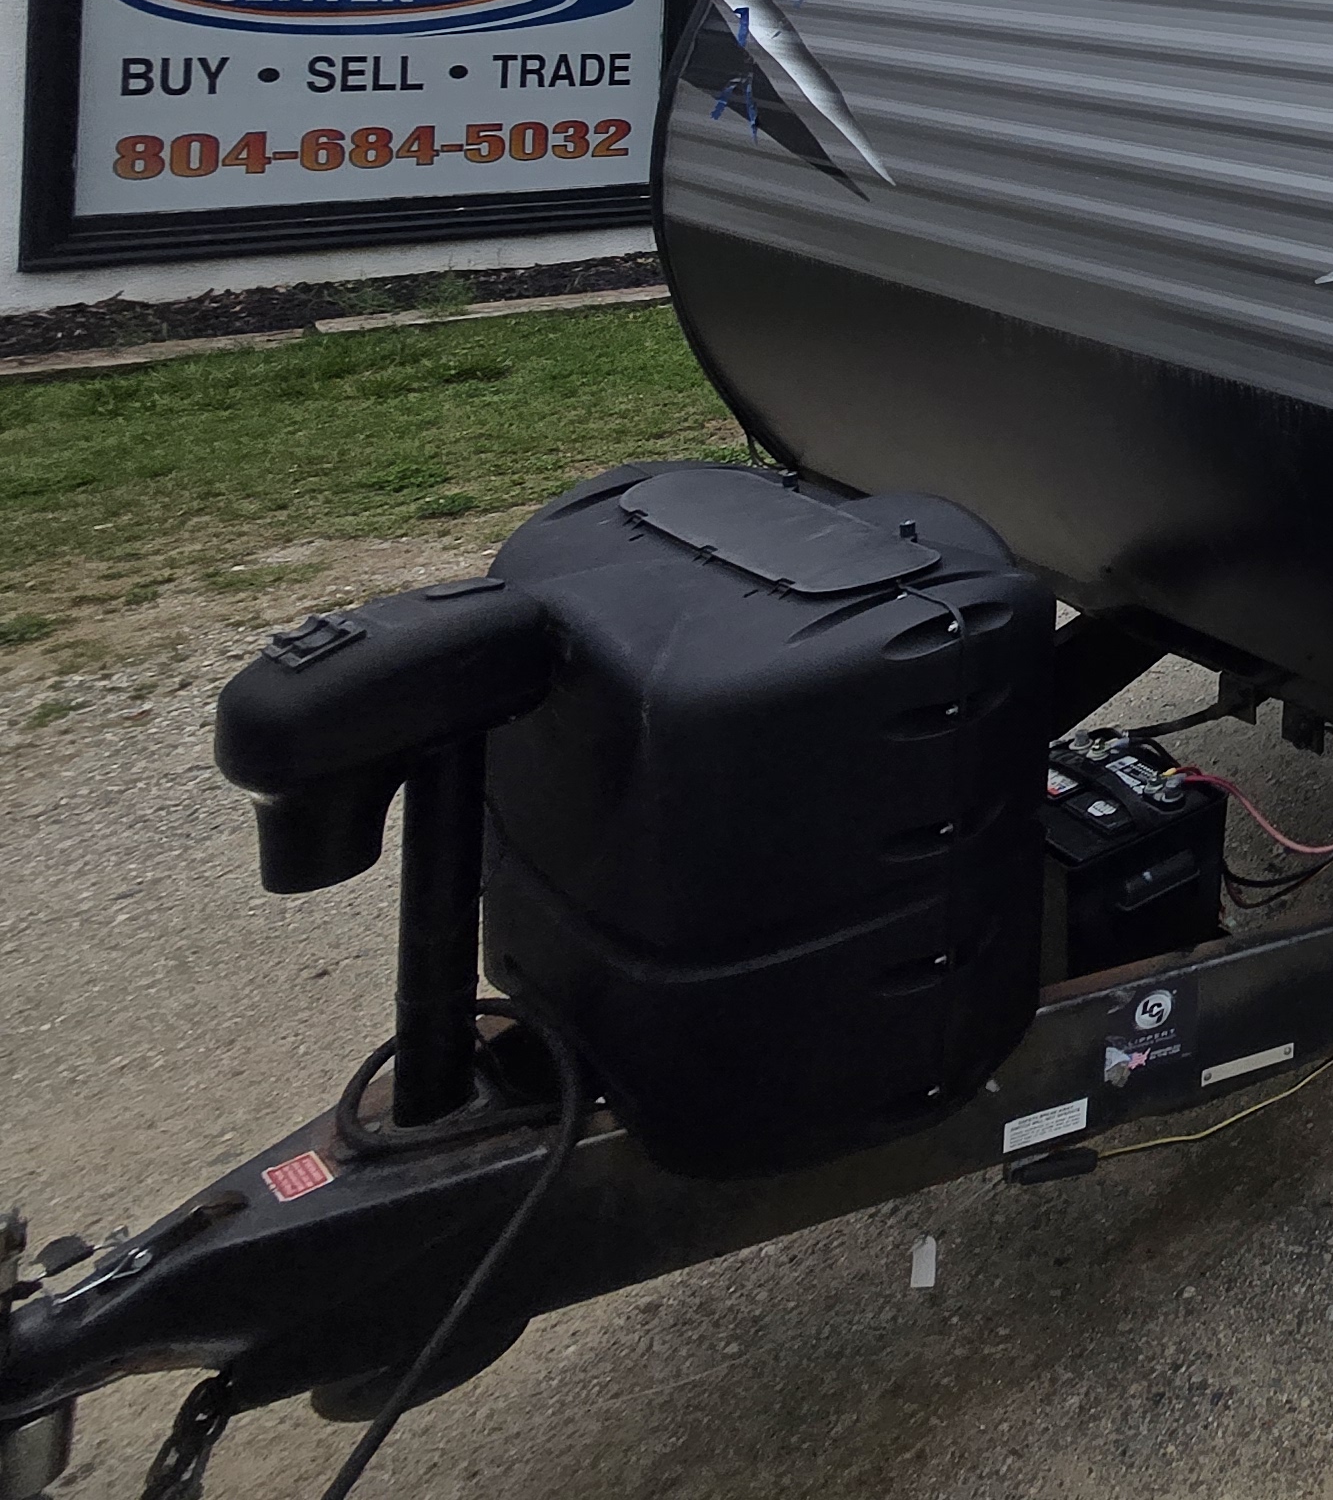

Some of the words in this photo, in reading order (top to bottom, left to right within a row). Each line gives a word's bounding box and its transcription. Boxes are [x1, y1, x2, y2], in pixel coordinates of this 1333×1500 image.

[120, 57, 230, 97] BUY
[306, 56, 424, 92] SELL
[493, 53, 632, 88] TRADE
[112, 118, 632, 181] 804-684-5032
